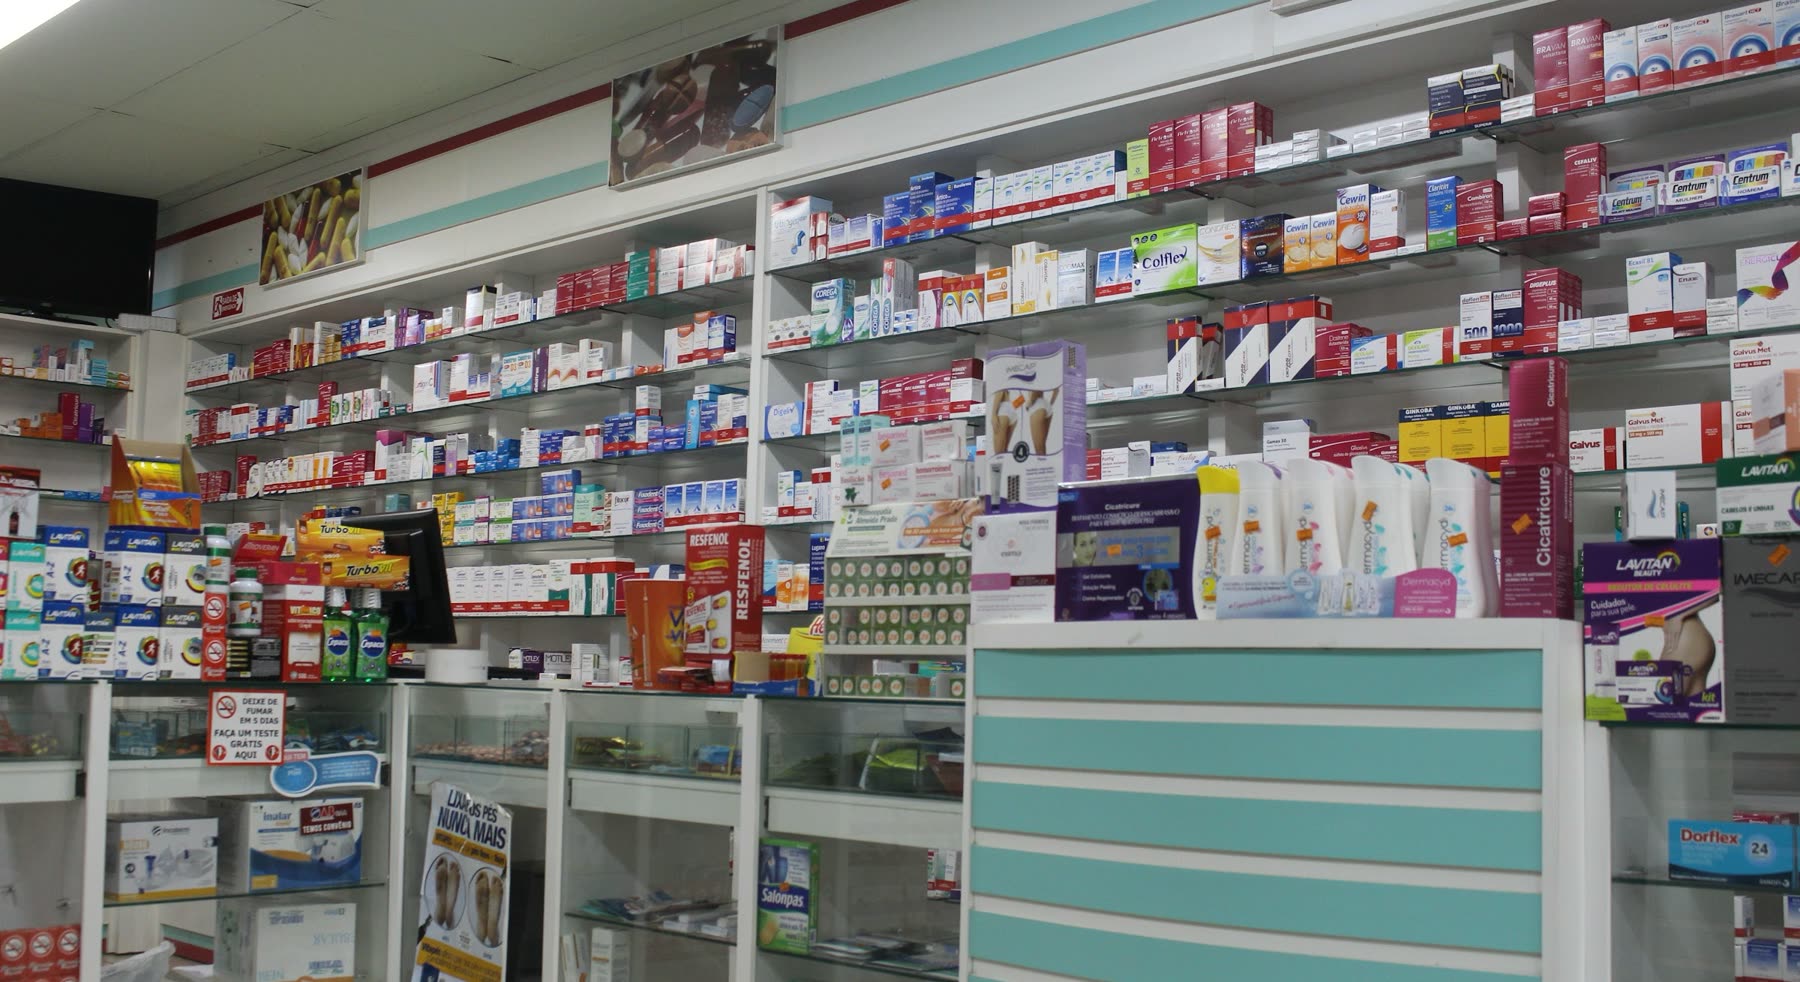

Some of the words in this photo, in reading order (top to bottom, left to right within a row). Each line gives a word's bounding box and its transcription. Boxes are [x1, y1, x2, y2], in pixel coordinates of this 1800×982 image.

[1571, 34, 1601, 46] BRAVAN
[1536, 42, 1566, 54] BRAVAN
[1574, 157, 1597, 166] CEFALIV
[1733, 172, 1768, 184] Centrum
[1672, 182, 1707, 194] Centrum
[1340, 194, 1366, 206] Cewin
[1612, 196, 1642, 207] Centrum
[1286, 223, 1308, 233] Cewin
[1312, 218, 1335, 228] Cewin
[1142, 246, 1188, 270] Colflex
[816, 287, 838, 298] COREGA
[1464, 326, 1487, 337] 500
[1494, 323, 1522, 334] 1000
[1547, 360, 1555, 407] Cicatricure
[1628, 418, 1649, 426] Galvus
[1570, 440, 1600, 449] Galvus
[1741, 464, 1788, 477] LAVITAN
[1537, 467, 1550, 566] Cicatricure
[690, 533, 729, 546] RESFENOL
[1363, 521, 1374, 574] ermacyd
[1616, 557, 1672, 571] LAVITAN
[736, 539, 750, 620] RESFENOL
[1402, 578, 1451, 586] Dermacyd
[1591, 599, 1626, 610] Cuidados
[1591, 610, 1606, 618] para
[328, 638, 348, 647] Cepaco
[361, 639, 384, 649] Cepaco
[215, 730, 235, 739] FAÇA
[230, 739, 262, 748] GRÁTIS
[235, 752, 257, 760] AQUI
[447, 789, 469, 812] LIXA
[482, 803, 497, 823] PÉS
[302, 824, 322, 834] TEMOS
[323, 821, 352, 832] CONVÊNIO
[474, 820, 506, 849] MAIS
[1680, 829, 1739, 844] Dorflex
[1752, 843, 1768, 854] 24
[761, 888, 804, 907] Salonpas
